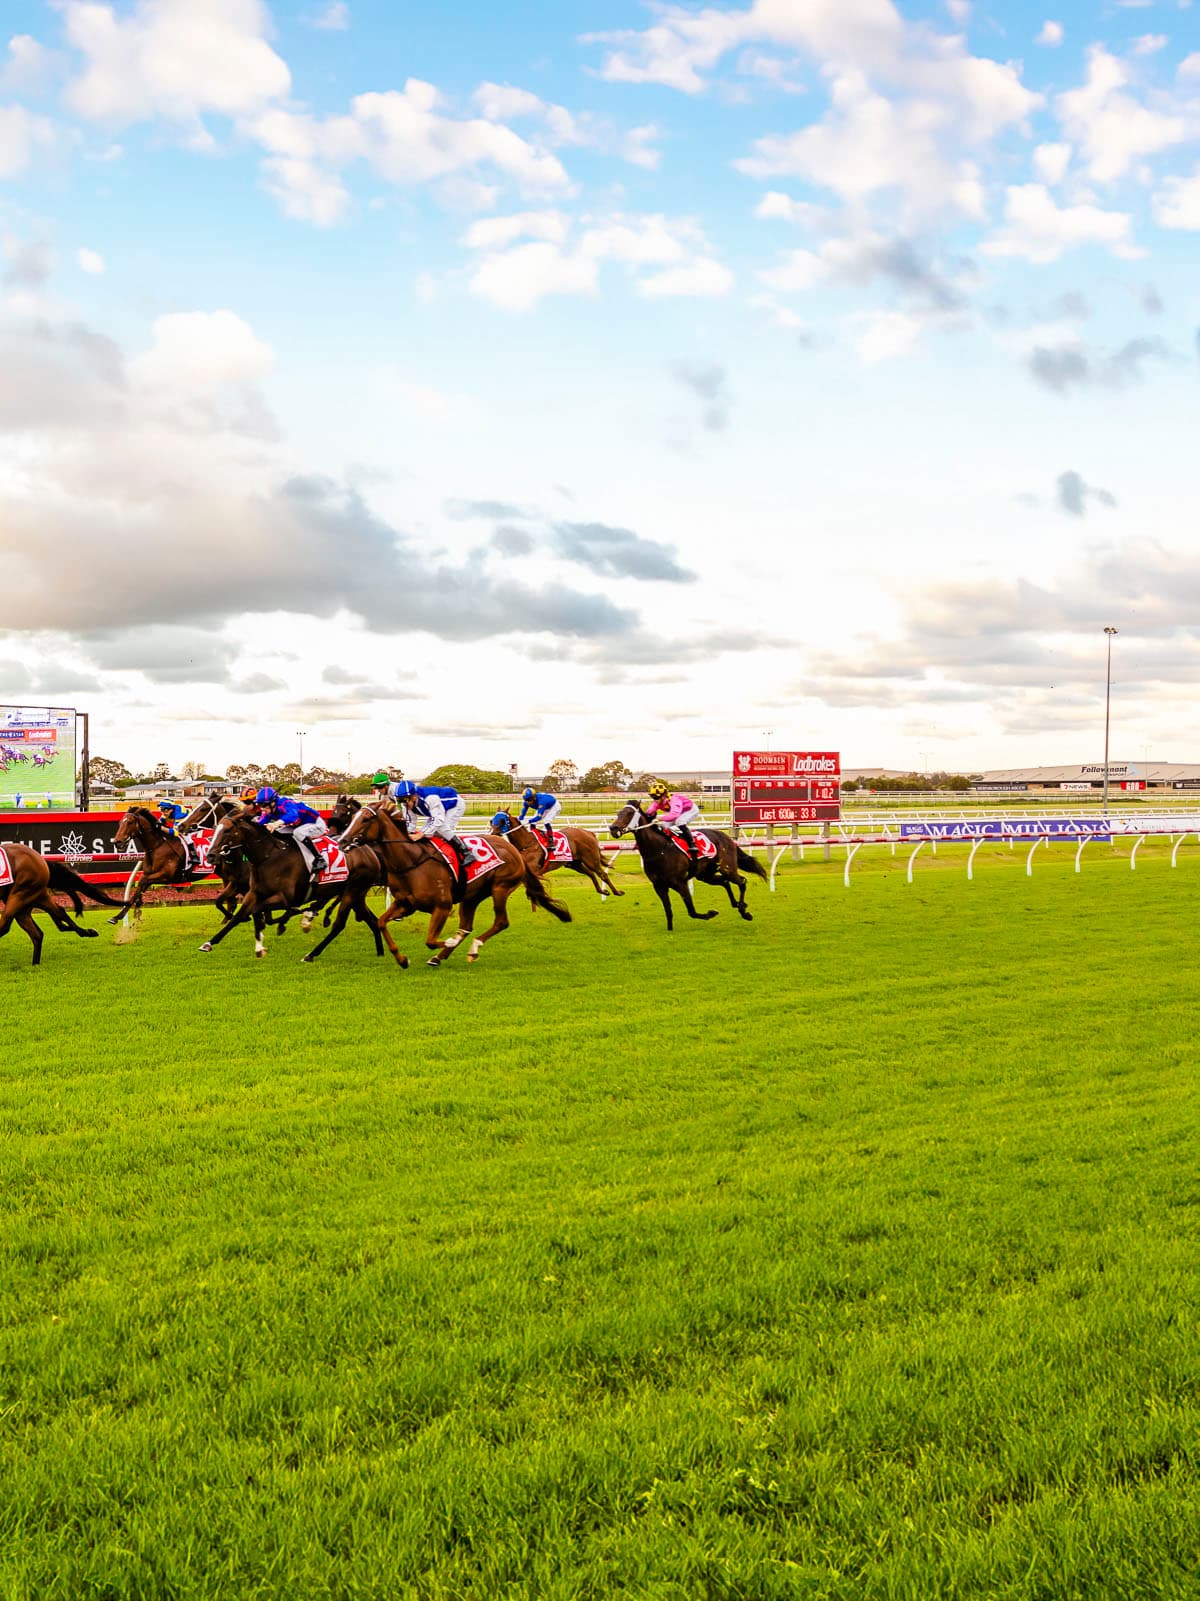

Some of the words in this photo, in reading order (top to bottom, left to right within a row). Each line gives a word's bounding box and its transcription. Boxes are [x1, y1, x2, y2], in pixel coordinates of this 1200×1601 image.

[793, 755, 835, 771] Ladbrokes
[760, 808, 777, 820] Last
[933, 824, 995, 837] MAGIC
[462, 837, 493, 862] 8
